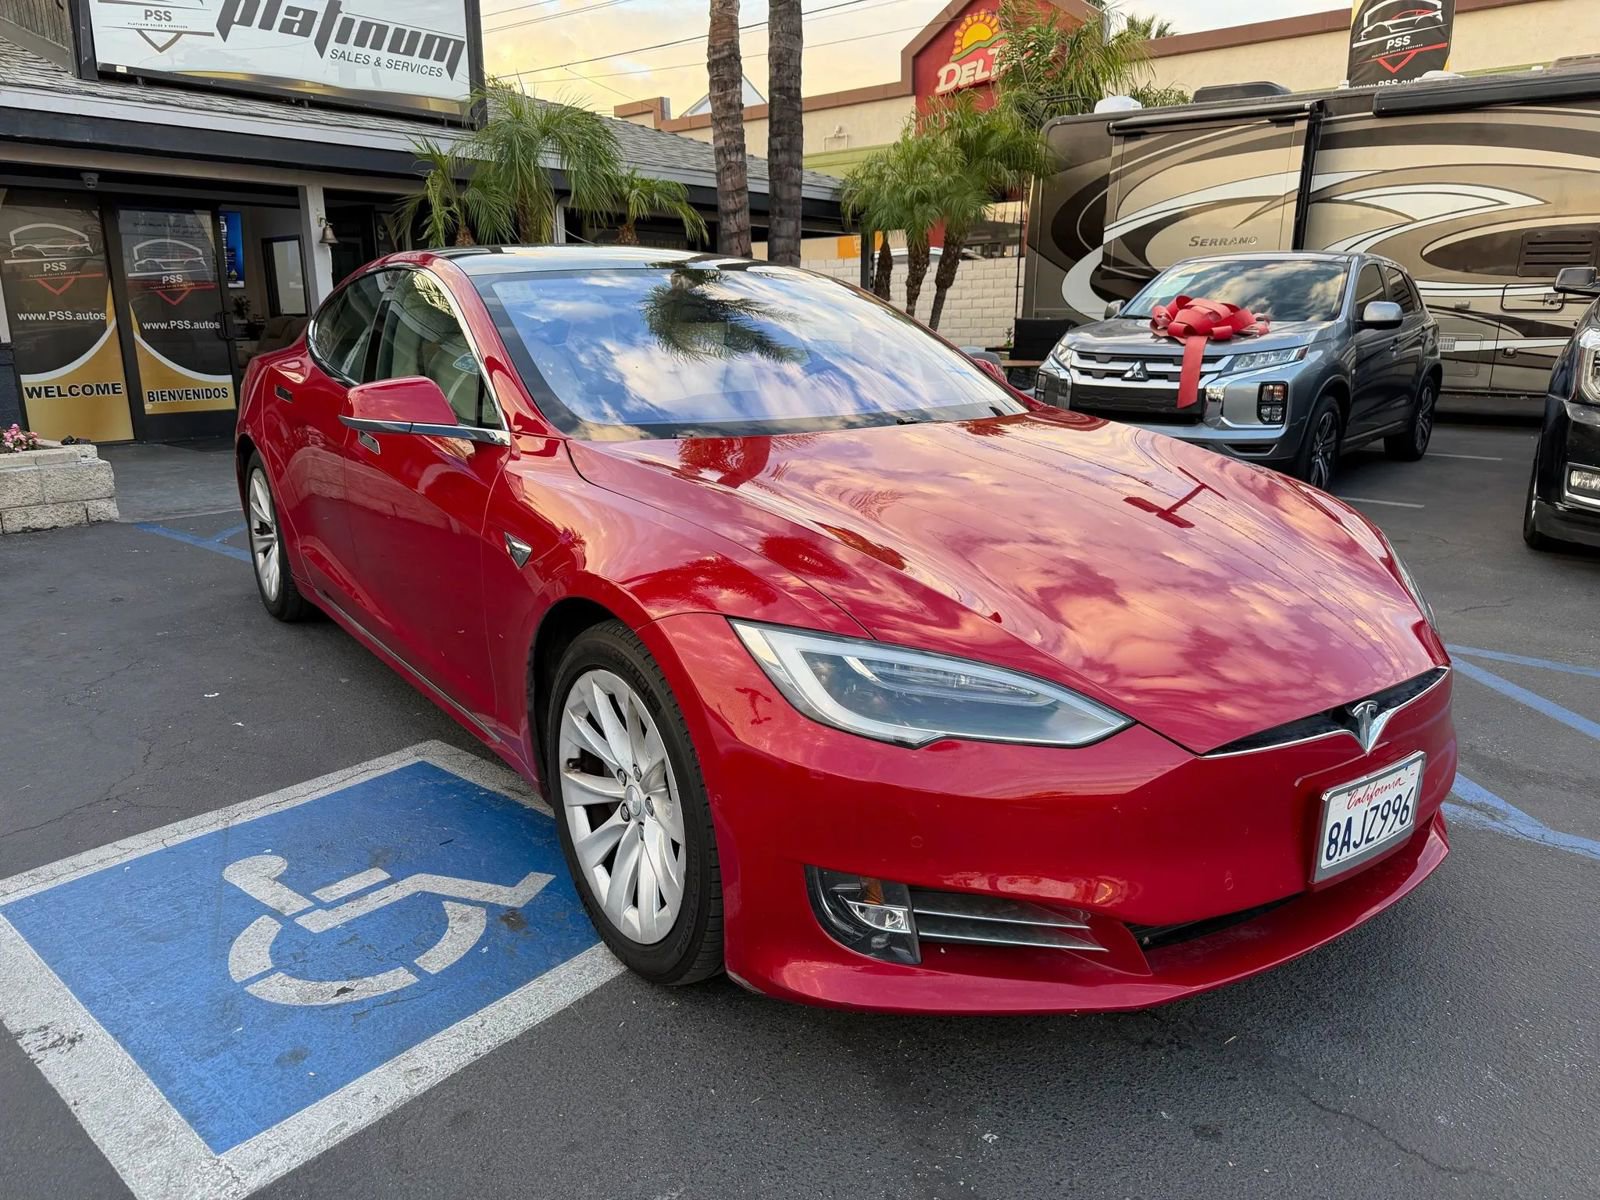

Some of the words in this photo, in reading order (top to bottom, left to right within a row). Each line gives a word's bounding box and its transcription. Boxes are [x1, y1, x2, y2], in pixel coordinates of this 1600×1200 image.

[144, 8, 173, 22] PSS
[216, 0, 466, 81] platinum
[1385, 35, 1412, 50] PSS
[329, 49, 370, 66] SALES
[373, 57, 382, 67] &
[385, 59, 444, 78] SERVICES
[935, 59, 990, 95] DEL
[1188, 235, 1258, 248] SERRANO
[43, 261, 67, 272] PSS
[162, 274, 183, 284] PSS
[17, 310, 106, 321] www.PSS.autos
[142, 320, 221, 330] www.PSS.autos
[25, 382, 123, 400] WELCOME
[147, 387, 229, 403] BIENVENIDOS
[1346, 776, 1406, 810] California
[1325, 787, 1414, 861] 8AJZ996
